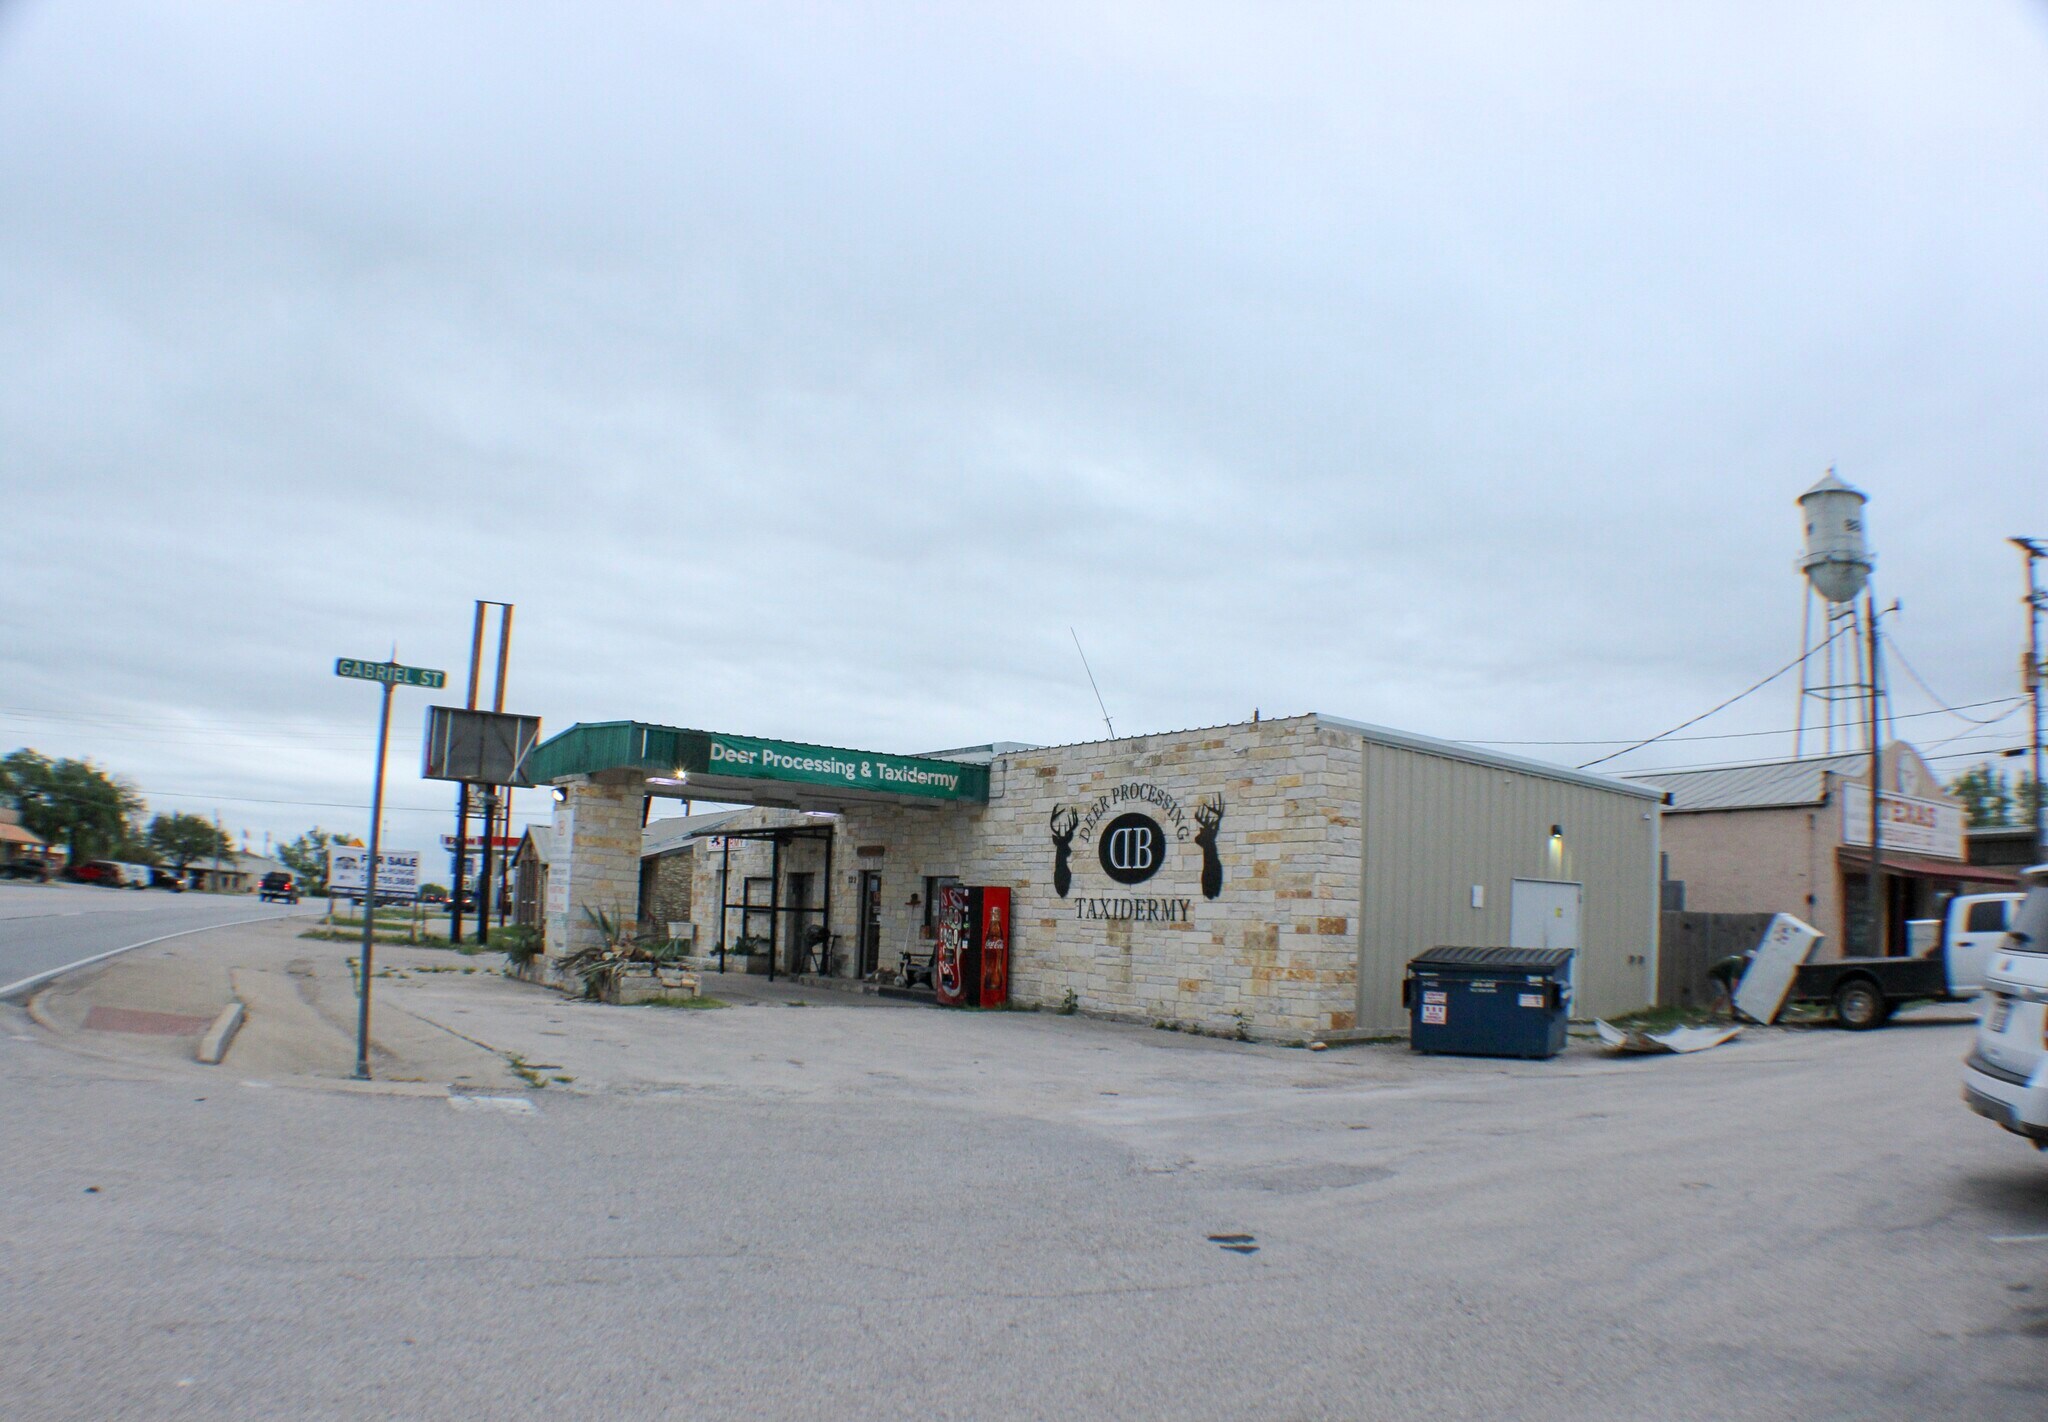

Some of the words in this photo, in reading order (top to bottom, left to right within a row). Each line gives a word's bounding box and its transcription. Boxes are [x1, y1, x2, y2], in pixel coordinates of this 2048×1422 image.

[340, 660, 413, 683] GABRIEL
[420, 671, 443, 687] ST
[710, 742, 758, 764] Deer
[763, 749, 856, 781] Processing
[861, 761, 872, 778] &
[876, 762, 959, 790] Taxidermy
[1079, 795, 1110, 843] DEER
[1111, 782, 1190, 841] PROCESSING
[361, 854, 384, 865] FR
[388, 856, 418, 867] SALE
[1074, 898, 1190, 922] TAXIDERMY
